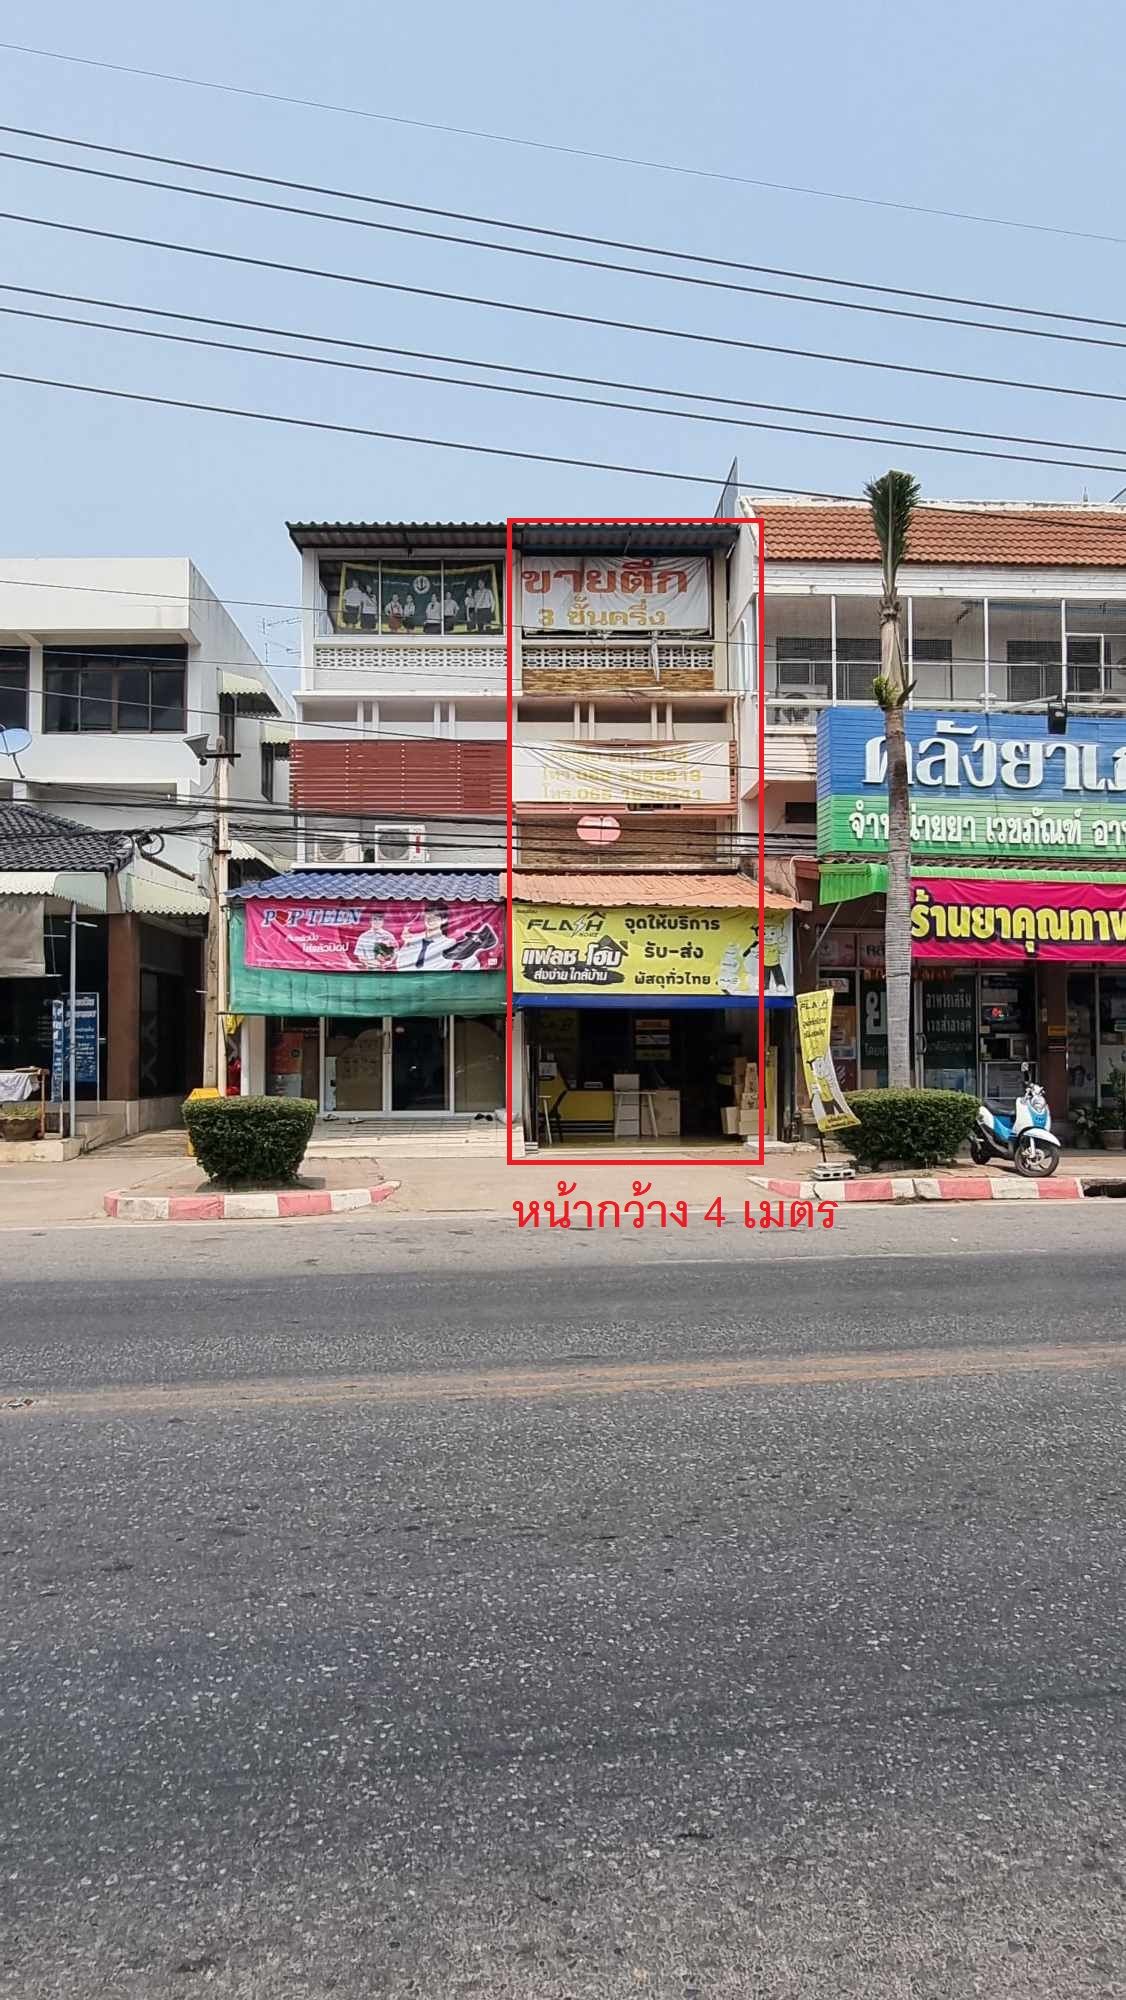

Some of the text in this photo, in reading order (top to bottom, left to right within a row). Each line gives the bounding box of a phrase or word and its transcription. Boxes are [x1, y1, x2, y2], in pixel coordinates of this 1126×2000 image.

[522, 559, 688, 594] ขายตึก
[538, 593, 667, 626] 3 ชั้นครึ่ง
[985, 807, 1082, 845] เวชภัณฑ์
[305, 907, 361, 927] TEEN
[625, 914, 721, 935] จุดให้บริการ
[522, 945, 578, 966] แฟลช
[644, 941, 704, 959] รับ-ส่ง
[634, 968, 711, 989] พัสดุทั่วไทย
